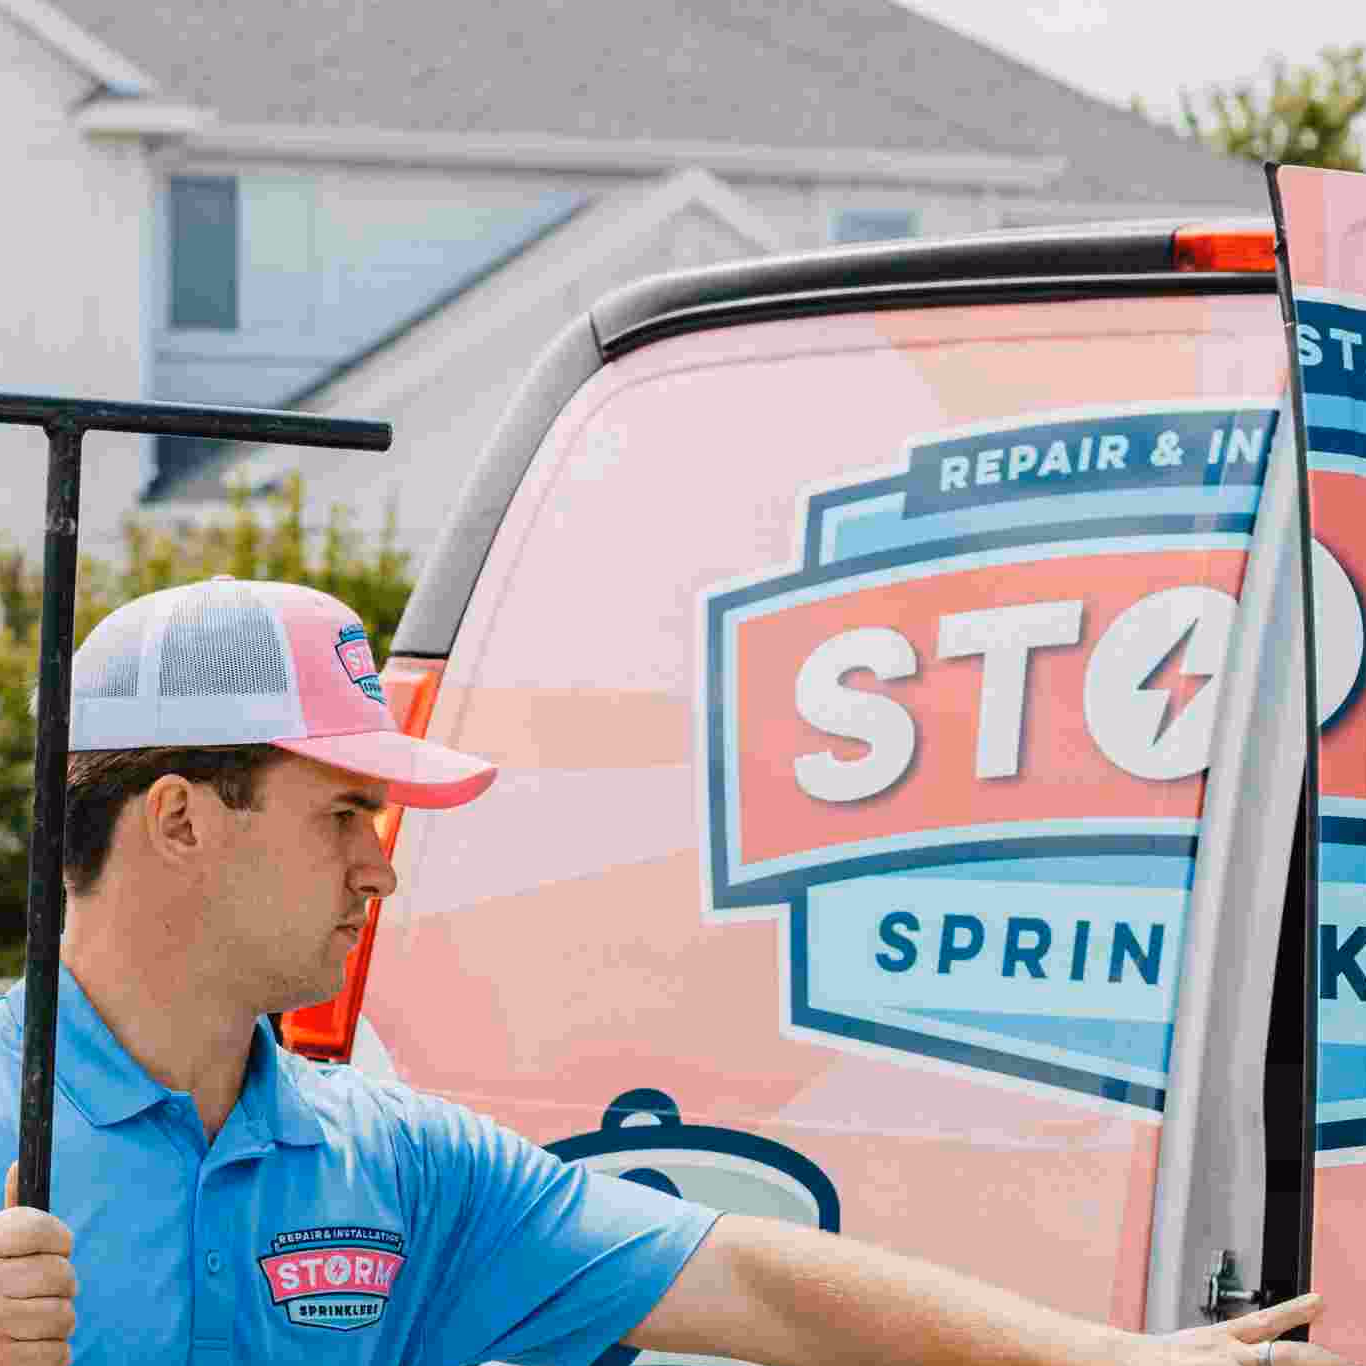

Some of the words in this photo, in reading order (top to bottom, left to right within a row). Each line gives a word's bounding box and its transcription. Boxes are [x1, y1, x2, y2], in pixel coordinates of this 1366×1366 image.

[938, 433, 1130, 491] REPAIR
[1149, 430, 1185, 467] &
[278, 1230, 323, 1244] REPAIR
[277, 1255, 396, 1290] STORM
